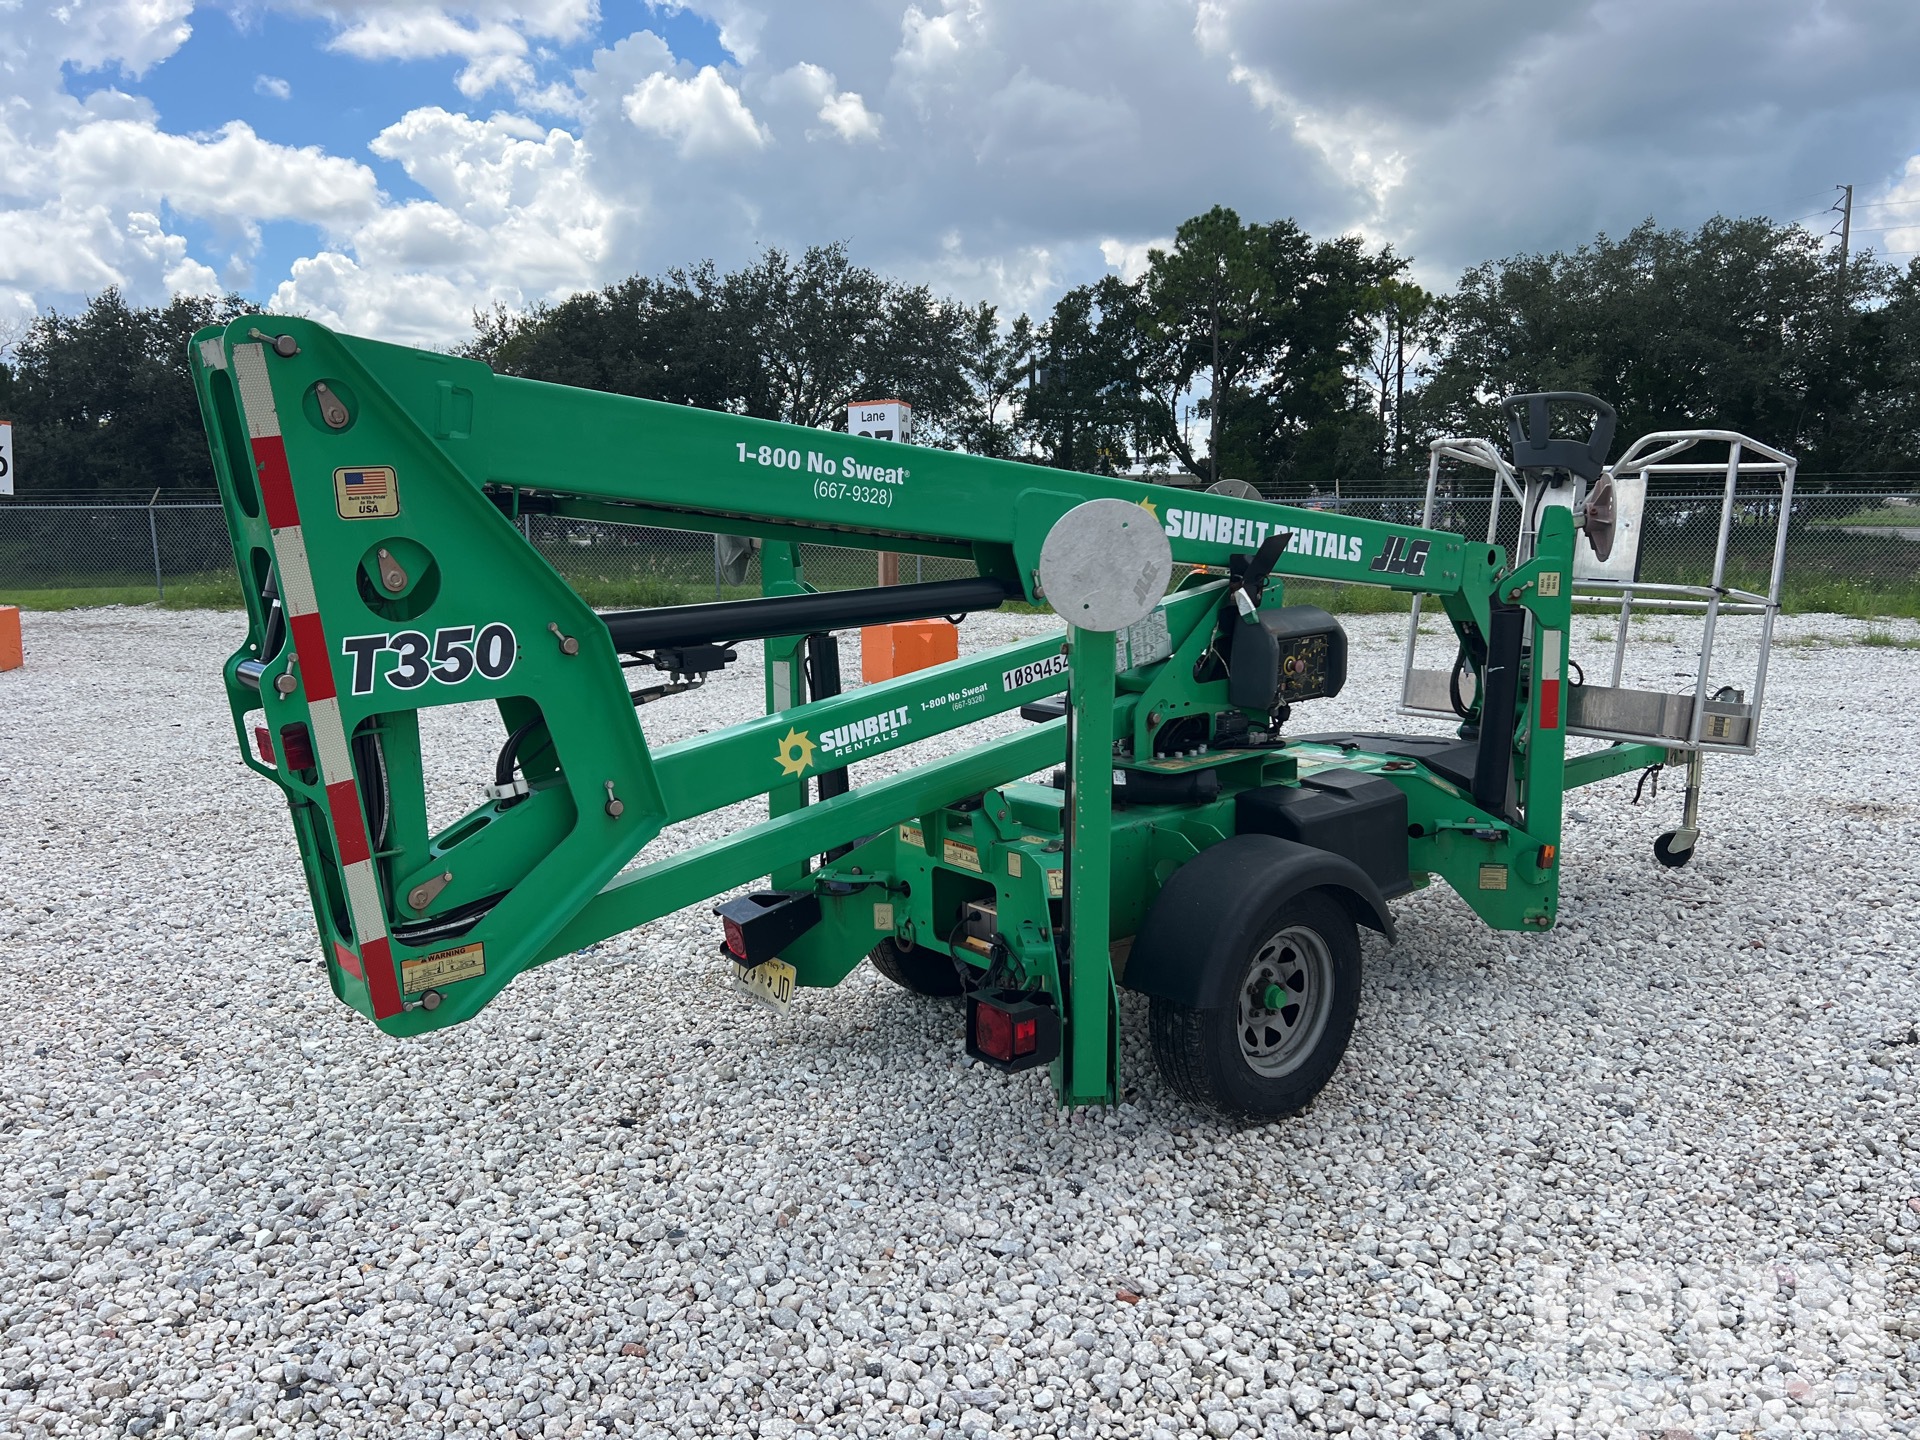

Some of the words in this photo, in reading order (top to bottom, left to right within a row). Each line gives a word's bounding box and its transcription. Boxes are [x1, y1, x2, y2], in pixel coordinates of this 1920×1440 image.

[861, 411, 885, 422] Lane
[736, 442, 801, 470] 1-800
[807, 450, 836, 476] No
[813, 478, 893, 508] (667-9328)
[358, 504, 379, 513] USA
[1165, 508, 1270, 549] SUNBELT
[342, 622, 517, 696] T350
[920, 696, 947, 711] 1-800
[948, 691, 960, 702] No
[961, 682, 988, 698] Sweat
[952, 693, 985, 712] (667-9328)
[835, 729, 899, 758] RENTALS
[427, 947, 466, 962] WARNING
[773, 975, 790, 1003] JD
